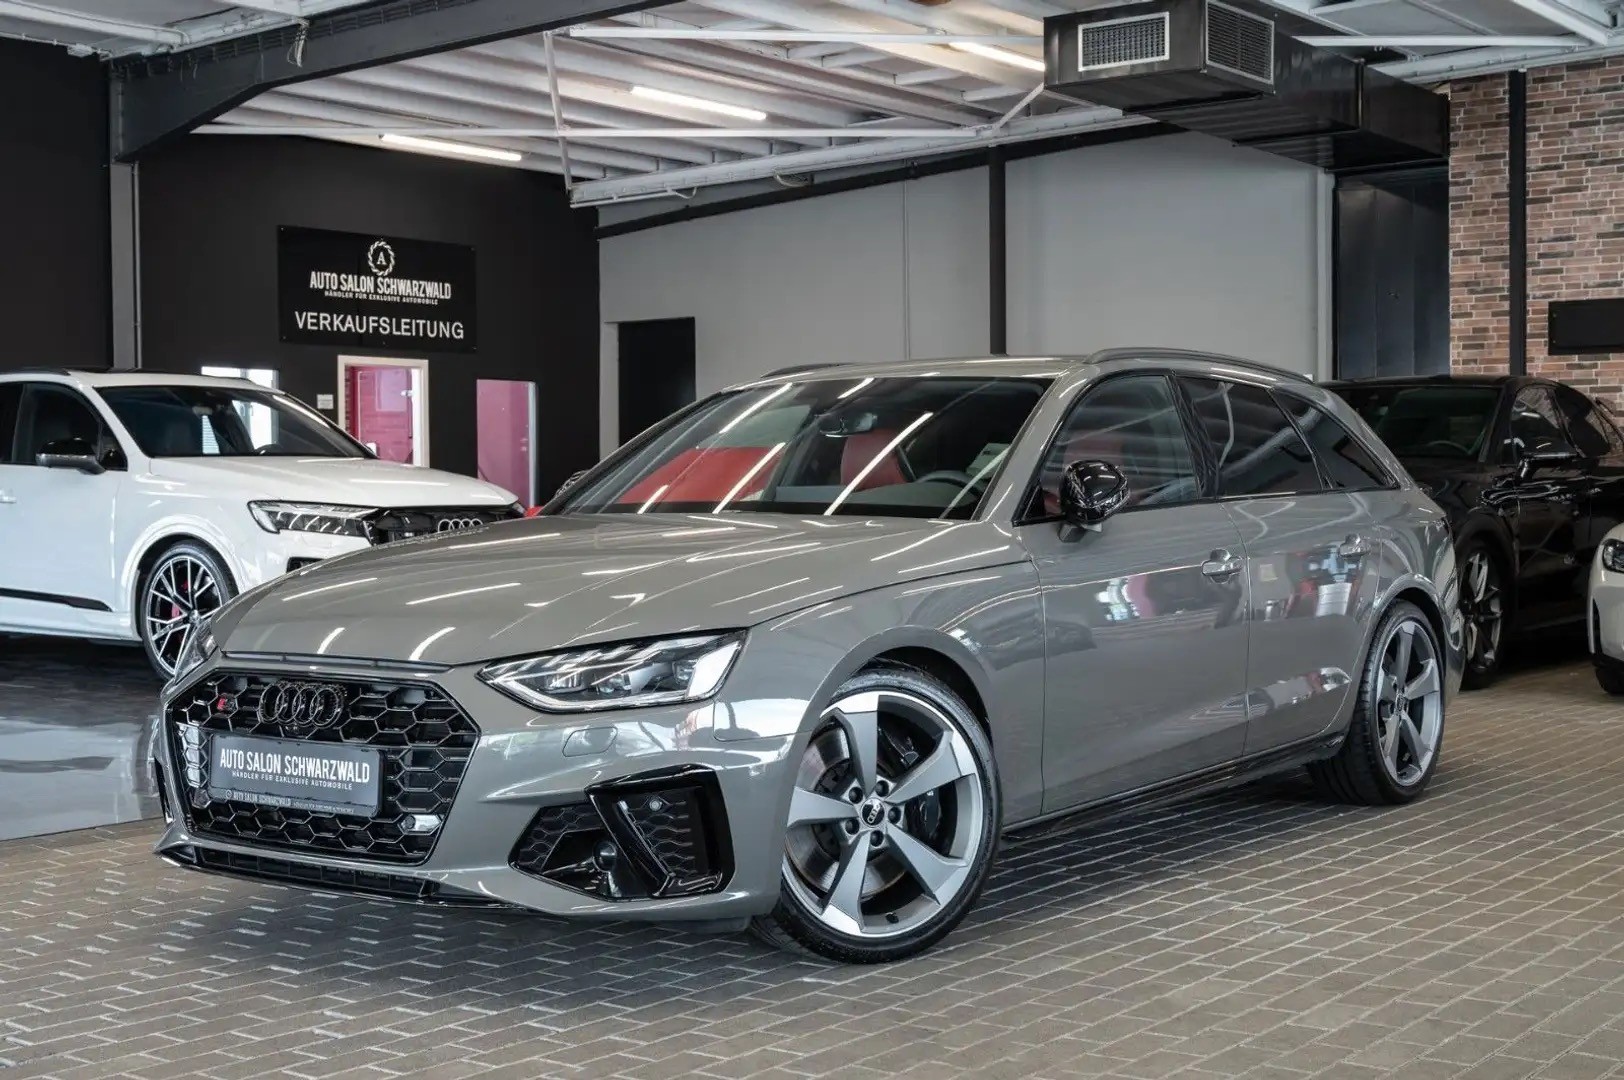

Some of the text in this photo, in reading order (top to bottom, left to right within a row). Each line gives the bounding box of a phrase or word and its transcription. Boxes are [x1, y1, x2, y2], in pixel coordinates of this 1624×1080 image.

[376, 251, 388, 265] A
[310, 271, 452, 299] AUTO SALON SCHWARZWALD
[324, 290, 438, 305] HÄNDLER FÜR EXKLUSIVE AUTOMOBILE
[295, 311, 464, 339] VERKAUFSLEITUNG
[220, 748, 370, 783] AUTO SALON SCHWARZWALD
[232, 770, 353, 790] HÄNDLER FÜR EXKLUSIVE AUTOMOBILE
